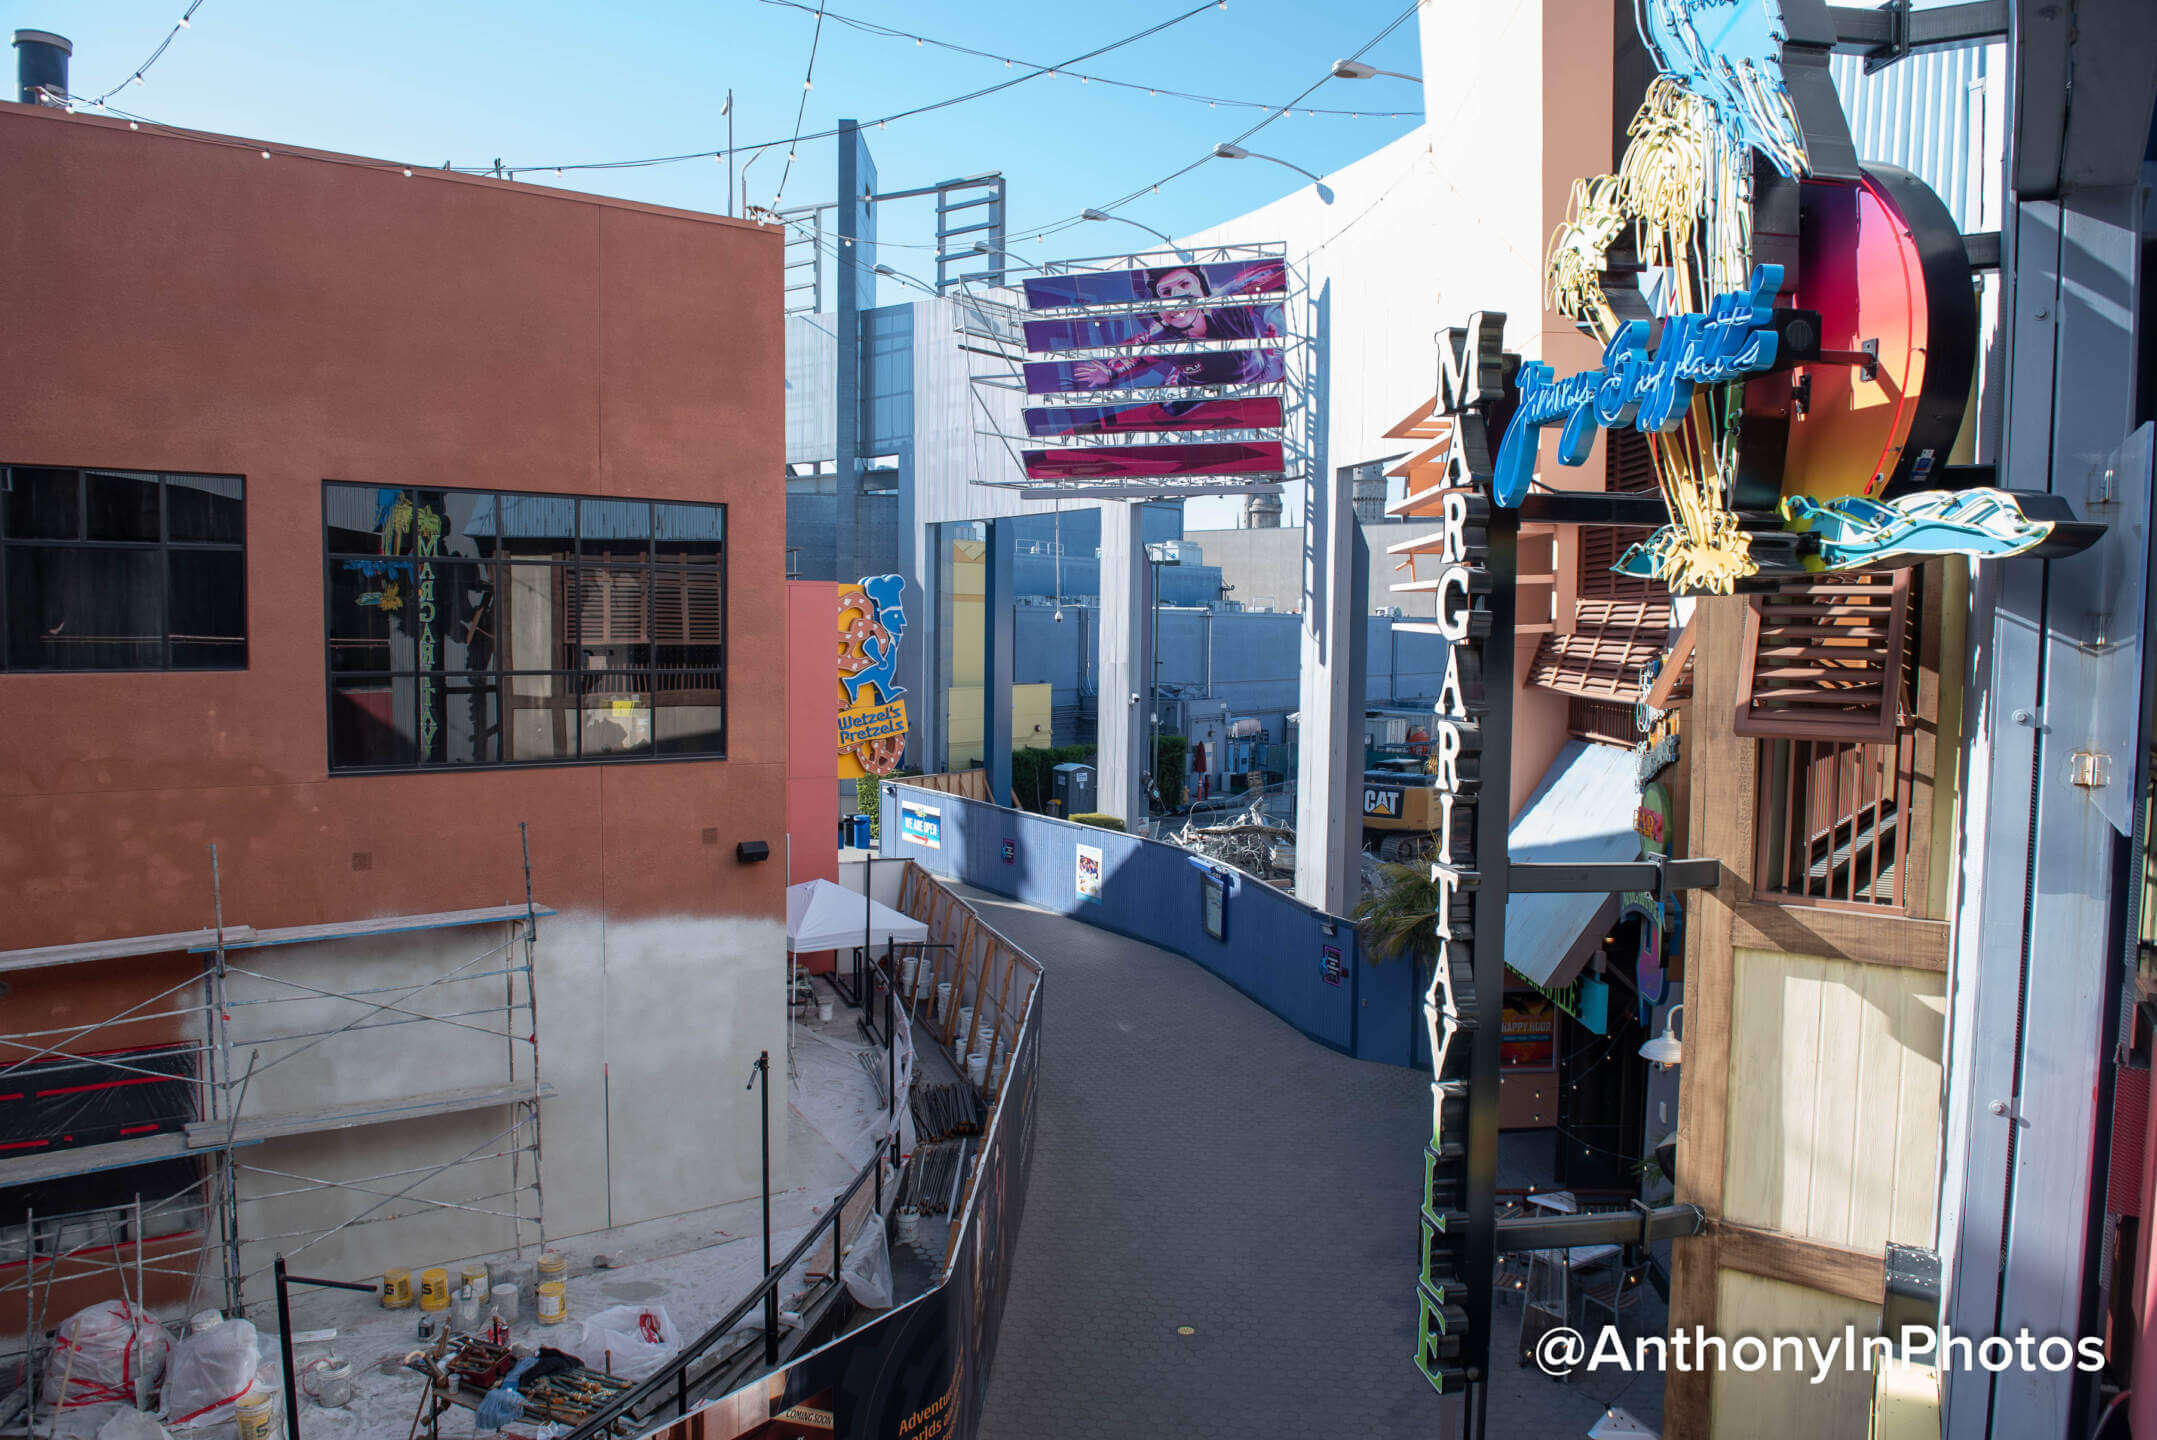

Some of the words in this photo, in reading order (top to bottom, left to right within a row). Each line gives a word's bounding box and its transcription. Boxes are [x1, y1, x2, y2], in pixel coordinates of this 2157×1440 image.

[837, 705, 902, 731] Wetzel's
[839, 720, 905, 745] Pretzels
[1364, 789, 1400, 815] CAT
[904, 816, 913, 829] WE
[913, 818, 923, 832] ARE
[923, 821, 938, 837] OPEN
[1413, 311, 1508, 1395] MARGARITAVILLE
[1501, 1021, 1528, 1033] HAPPY
[1529, 1021, 1552, 1033] HOUR
[786, 1408, 813, 1423] COMING
[813, 1413, 833, 1425] SOON
